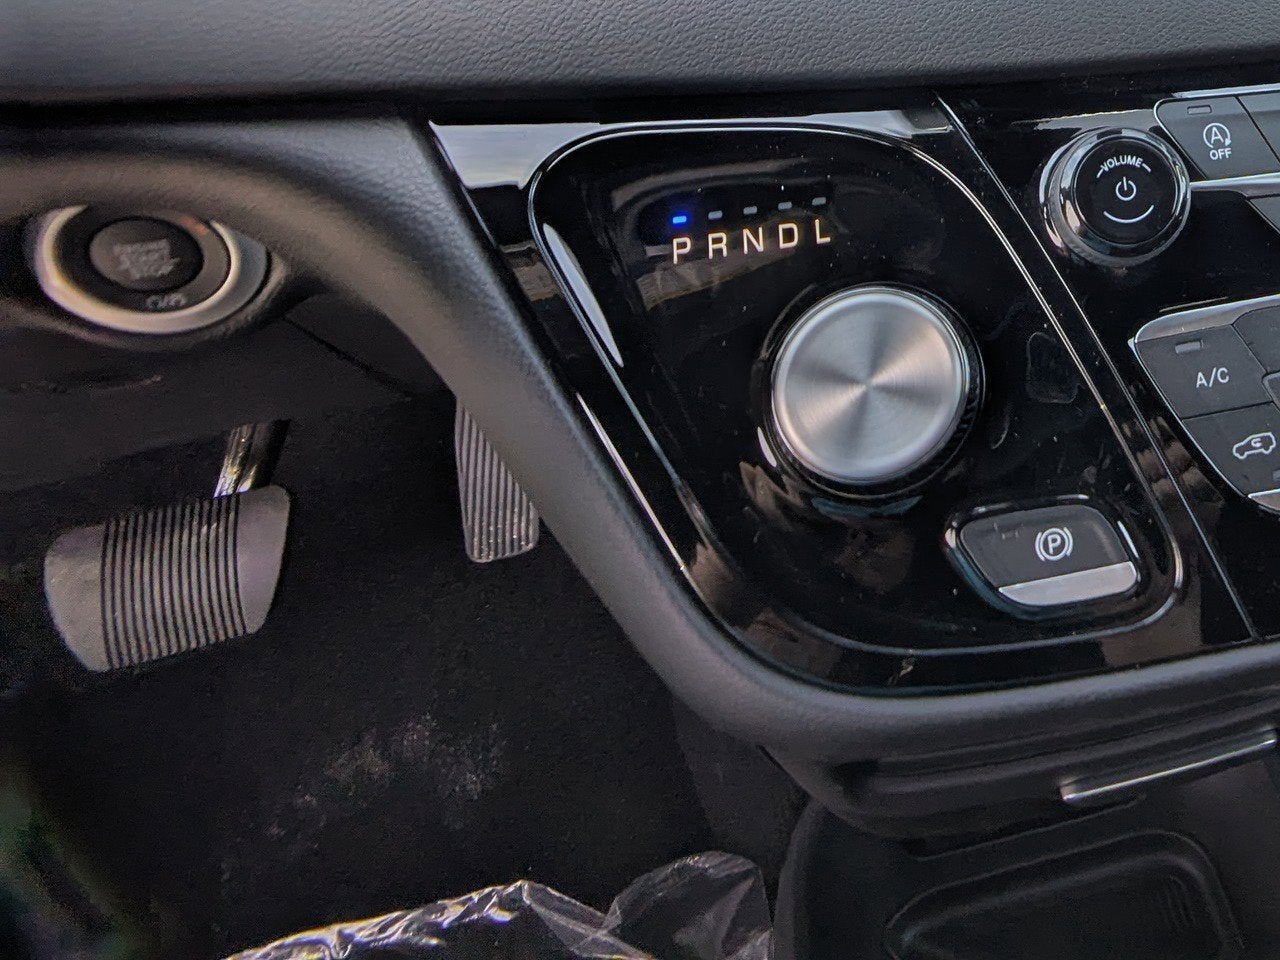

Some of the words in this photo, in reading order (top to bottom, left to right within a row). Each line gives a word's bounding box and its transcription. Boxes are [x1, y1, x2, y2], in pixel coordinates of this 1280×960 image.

[1209, 147, 1232, 161] OFF
[1100, 155, 1144, 172] VOLUME
[1195, 366, 1230, 388] A/C
